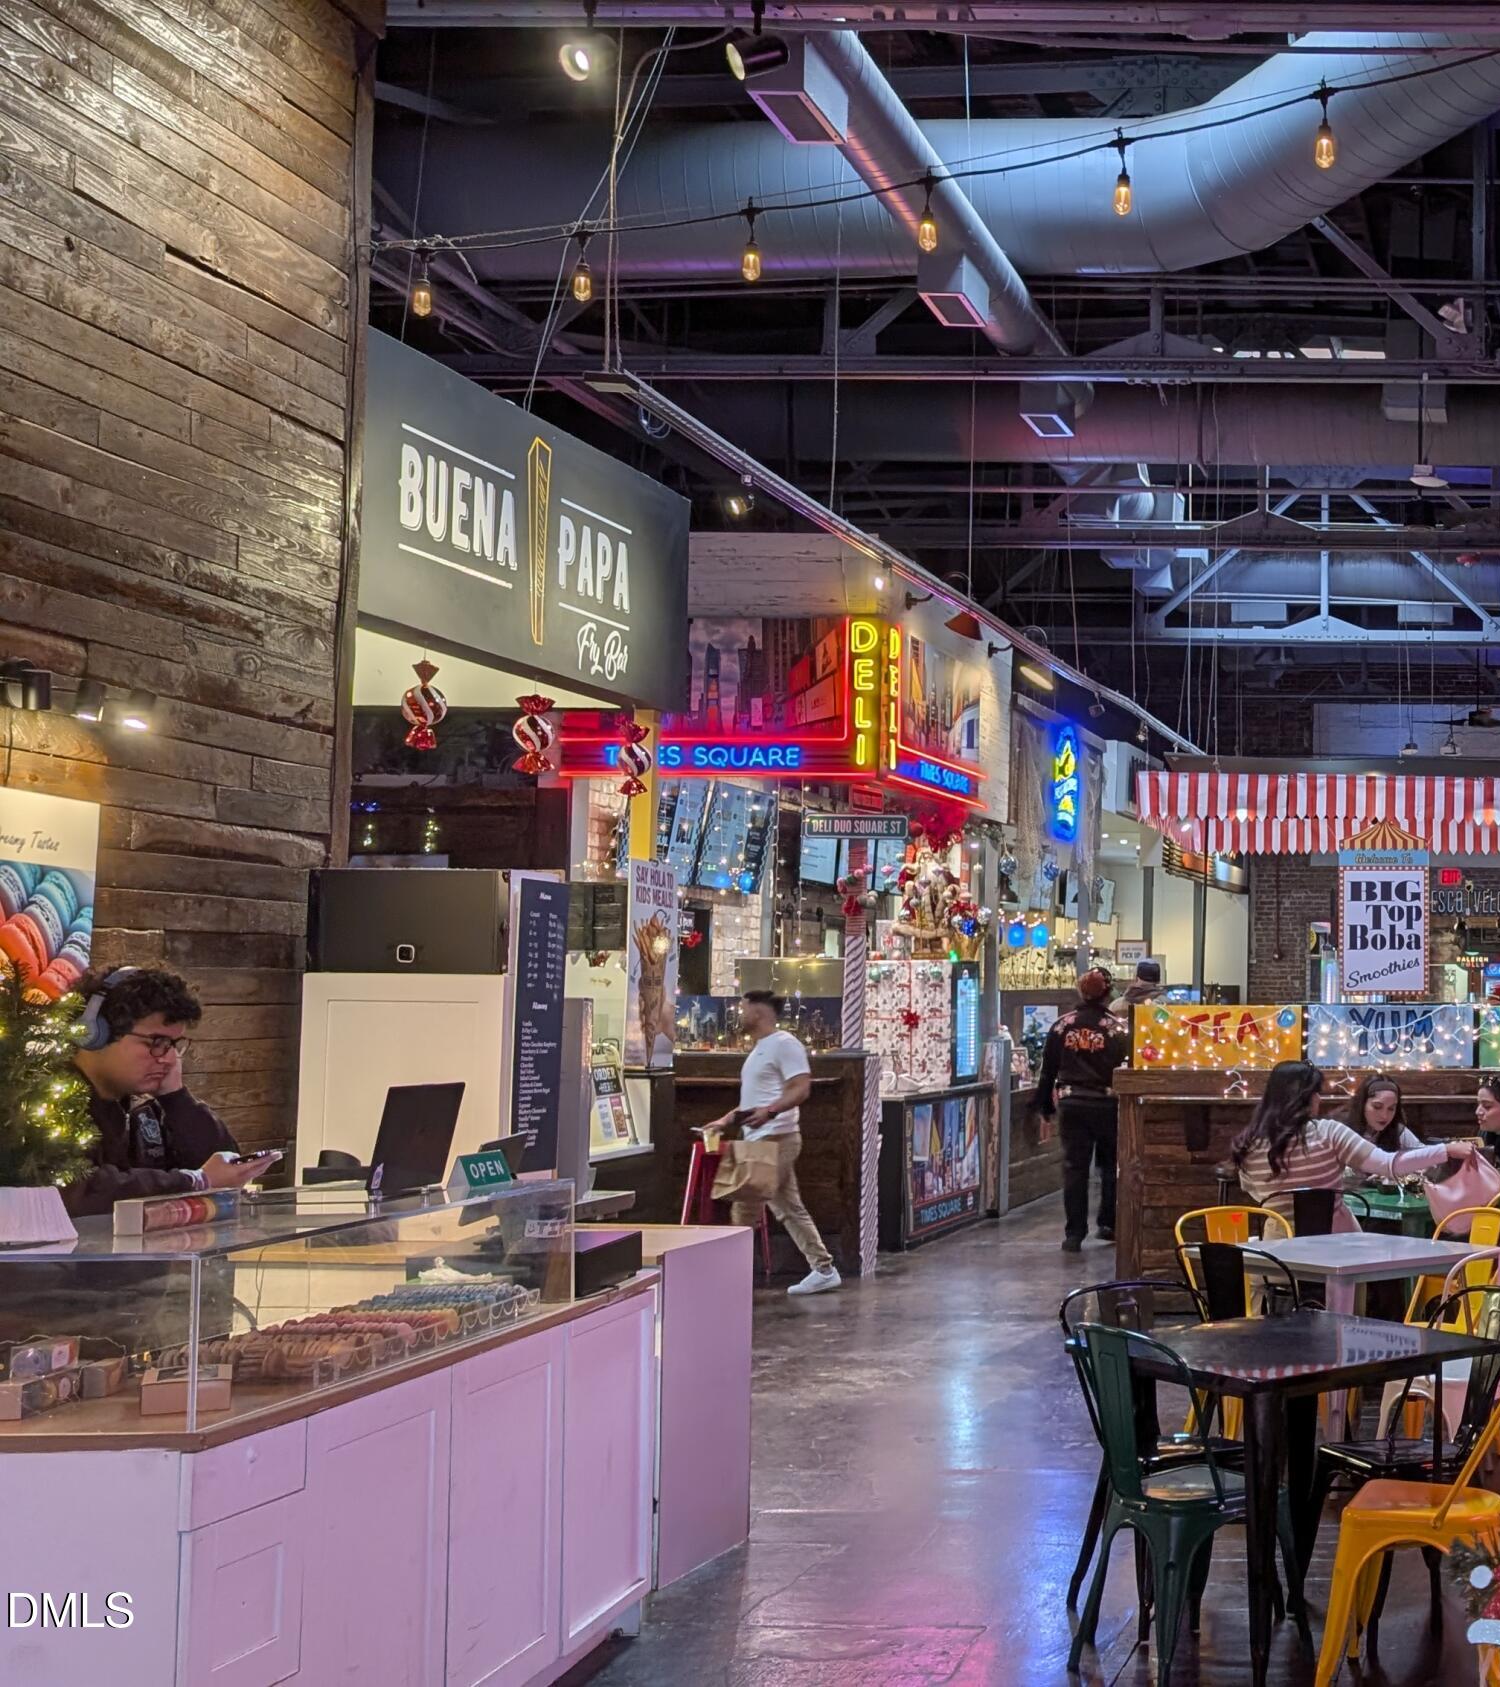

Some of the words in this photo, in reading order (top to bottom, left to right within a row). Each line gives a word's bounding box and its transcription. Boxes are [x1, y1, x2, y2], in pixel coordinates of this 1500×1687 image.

[398, 443, 519, 571] BUENA
[557, 514, 632, 614] PAPA
[577, 622, 604, 674] Fry
[603, 630, 629, 682] Bar
[851, 620, 878, 767] DELI
[888, 626, 902, 771] DELI
[604, 745, 682, 767] TES
[693, 745, 801, 768] SQUARE
[811, 820, 832, 833] DELI
[834, 820, 852, 833] DUO
[854, 820, 888, 834] SQUARE
[890, 821, 902, 834] ST
[30, 830, 60, 852] Tastes
[1355, 854, 1399, 864] Welcome
[1401, 854, 1413, 864] To
[635, 864, 649, 883] SAY
[650, 866, 667, 888] HOLA
[667, 872, 674, 889] TO
[635, 886, 651, 905] KIDS
[652, 888, 674, 909] MEALS!
[1347, 880, 1421, 902] BIG
[1431, 890, 1464, 913] ESCO
[1365, 904, 1422, 930] Top
[1347, 924, 1421, 951] Boba
[1346, 957, 1421, 988] Smoothies
[1179, 1011, 1263, 1047] TEA
[1348, 1005, 1437, 1055] YUM
[593, 1066, 616, 1080] ORDER
[469, 1160, 505, 1179] OPEN
[920, 1205, 938, 1224] TIMES
[938, 1197, 962, 1218] SQUARE
